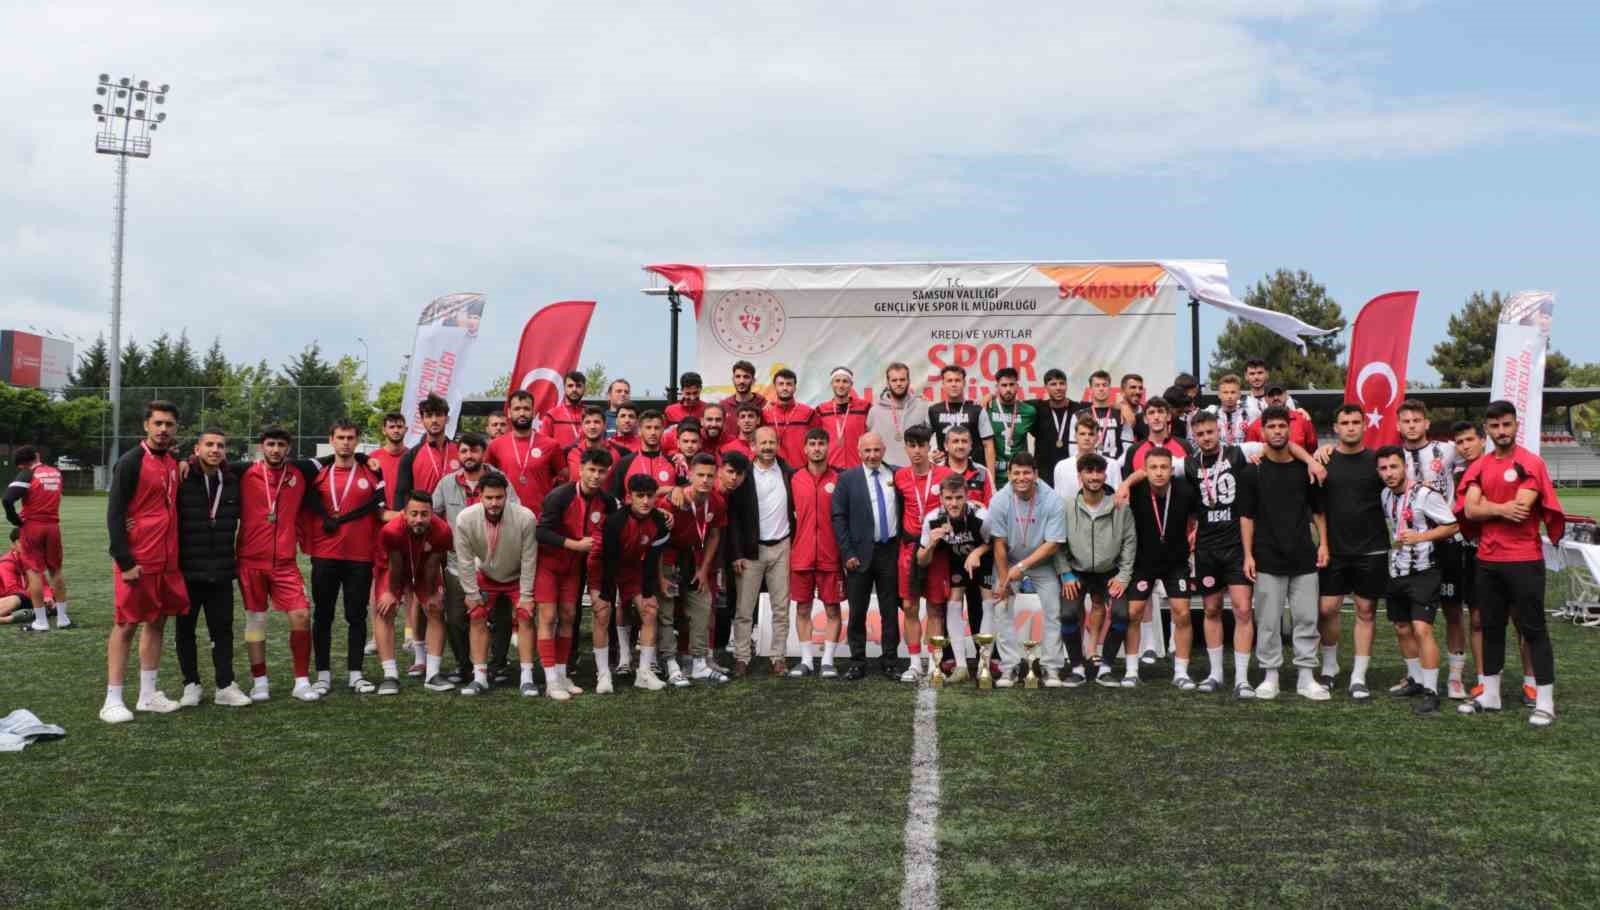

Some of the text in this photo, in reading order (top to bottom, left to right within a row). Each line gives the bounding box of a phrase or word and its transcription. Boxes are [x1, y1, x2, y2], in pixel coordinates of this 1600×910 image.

[946, 277, 964, 289] T.C.
[912, 288, 954, 300] SAMSUN
[1058, 281, 1156, 299] SAMSUN
[917, 302, 929, 312] VE
[932, 301, 958, 312] SPOR
[966, 328, 979, 339] VE
[982, 328, 1032, 339] YURTLAR
[927, 343, 1036, 382] SPOR
